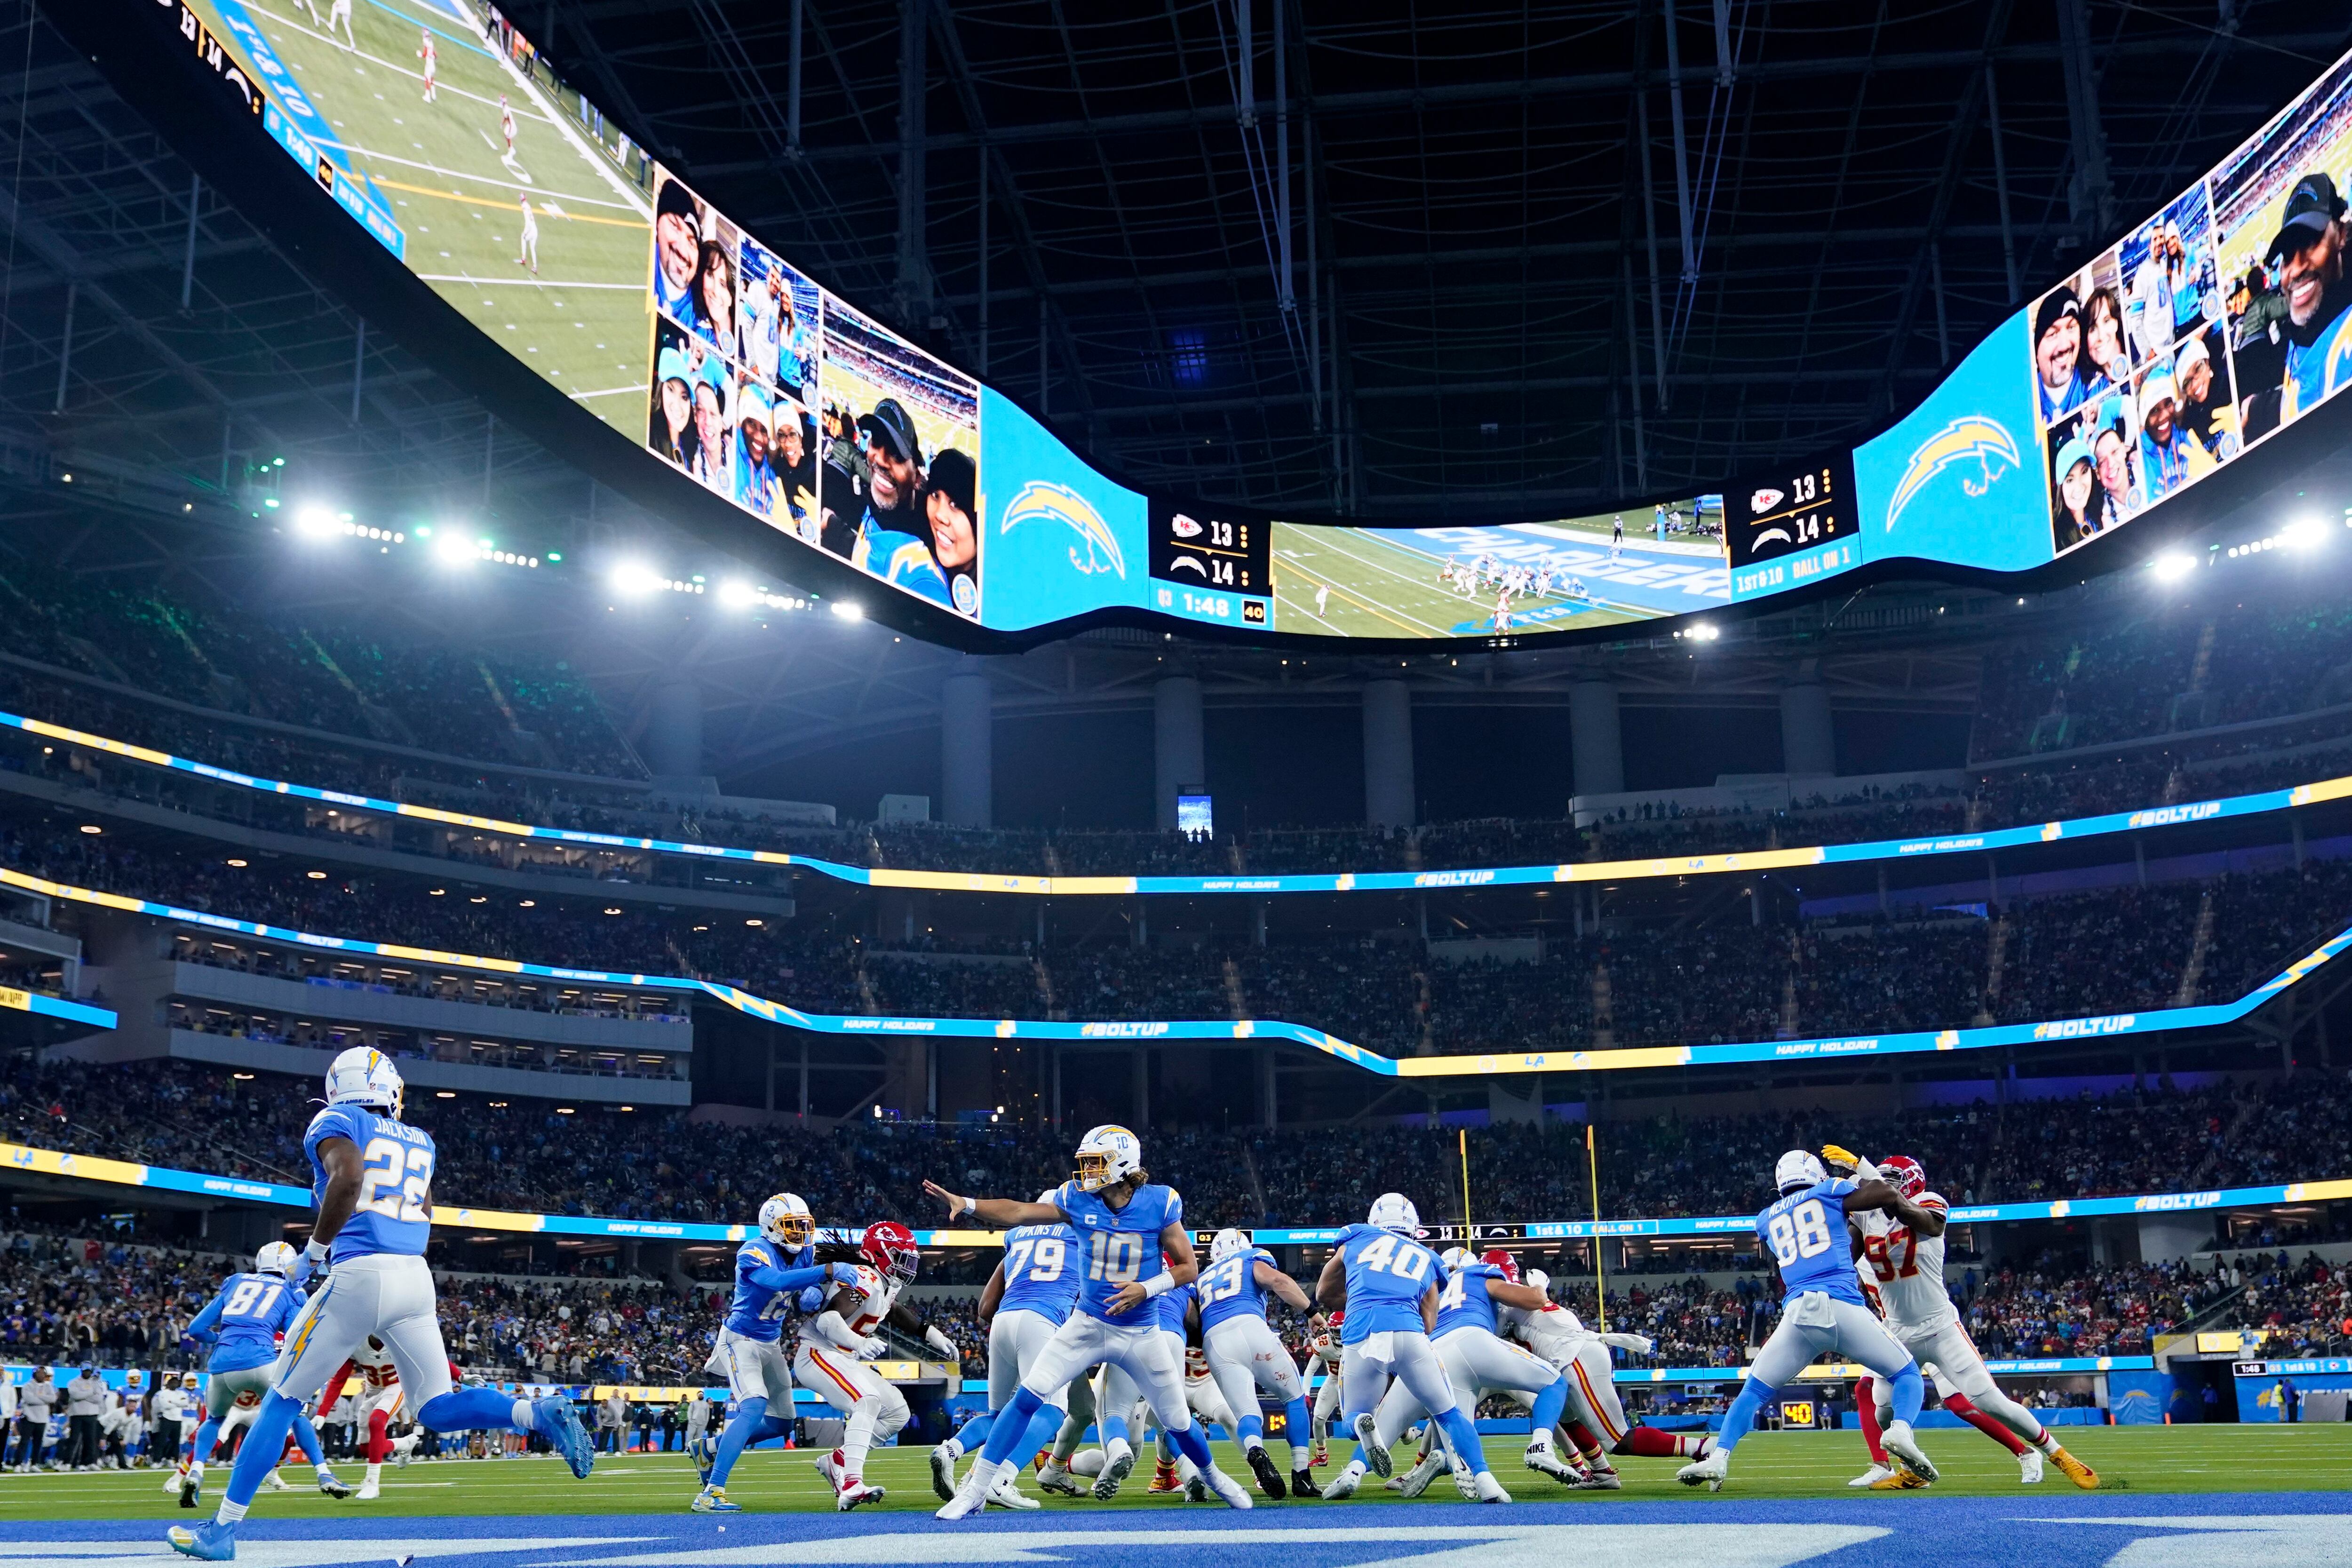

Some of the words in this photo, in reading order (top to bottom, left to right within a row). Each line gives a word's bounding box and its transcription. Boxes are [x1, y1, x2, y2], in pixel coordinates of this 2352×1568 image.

[180, 6, 196, 41] 13
[1793, 474, 1816, 504] 13
[1211, 521, 1232, 547] 13
[1796, 514, 1820, 543] 14
[1212, 560, 1234, 586] 14
[1793, 558, 1822, 578] BALL
[1824, 548, 1839, 568] ON
[1843, 546, 1850, 564] 1
[1184, 593, 1230, 617] 1:48
[1244, 606, 1264, 619] 40
[2129, 803, 2220, 828] #BOLTUP
[1899, 843, 1933, 852] HAPPY
[1935, 838, 1984, 850] HOLIDAYS
[1415, 871, 1494, 886] #BOLTUP
[843, 1019, 881, 1029] HAPPY
[882, 1021, 936, 1031] HOLIDAYS
[1081, 1022, 1169, 1036] #BOLTUP
[2034, 1015, 2135, 1039] #BOLTUP
[1776, 1043, 1817, 1055] HAPPY
[1819, 1039, 1878, 1052] HOLIDAYS
[374, 1117, 427, 1146] JACKSON
[1116, 1136, 1128, 1149] 10
[356, 1138, 432, 1222] 22
[1949, 1209, 1999, 1219] HOLIDAYS
[2135, 1192, 2221, 1211] #BOLTUP
[608, 1223, 638, 1233] HAPPY
[639, 1226, 683, 1235] HOLIDAYS
[1016, 1224, 1051, 1239] PIPKINS
[1084, 1215, 1097, 1225] C
[1440, 1227, 1453, 1240] 13
[1469, 1226, 1482, 1239] 14
[1619, 1224, 1633, 1232] ON
[1769, 1199, 1831, 1269] 88
[1005, 1238, 1065, 1290] 79
[1089, 1231, 1143, 1283] 10
[1356, 1234, 1430, 1282] 40
[1865, 1226, 1920, 1282] 97
[1196, 1256, 1244, 1315] 63
[221, 1281, 284, 1318] 81
[1318, 1335, 1329, 1347] 22
[361, 1364, 400, 1387] 32
[1831, 1366, 1847, 1376] LA
[2018, 1361, 2062, 1370] HOLIDAYS
[2241, 1364, 2261, 1373] 1:48
[1785, 1403, 1811, 1424] 40
[946, 1444, 955, 1459] NIKE
[1526, 1442, 1545, 1455] NIKE
